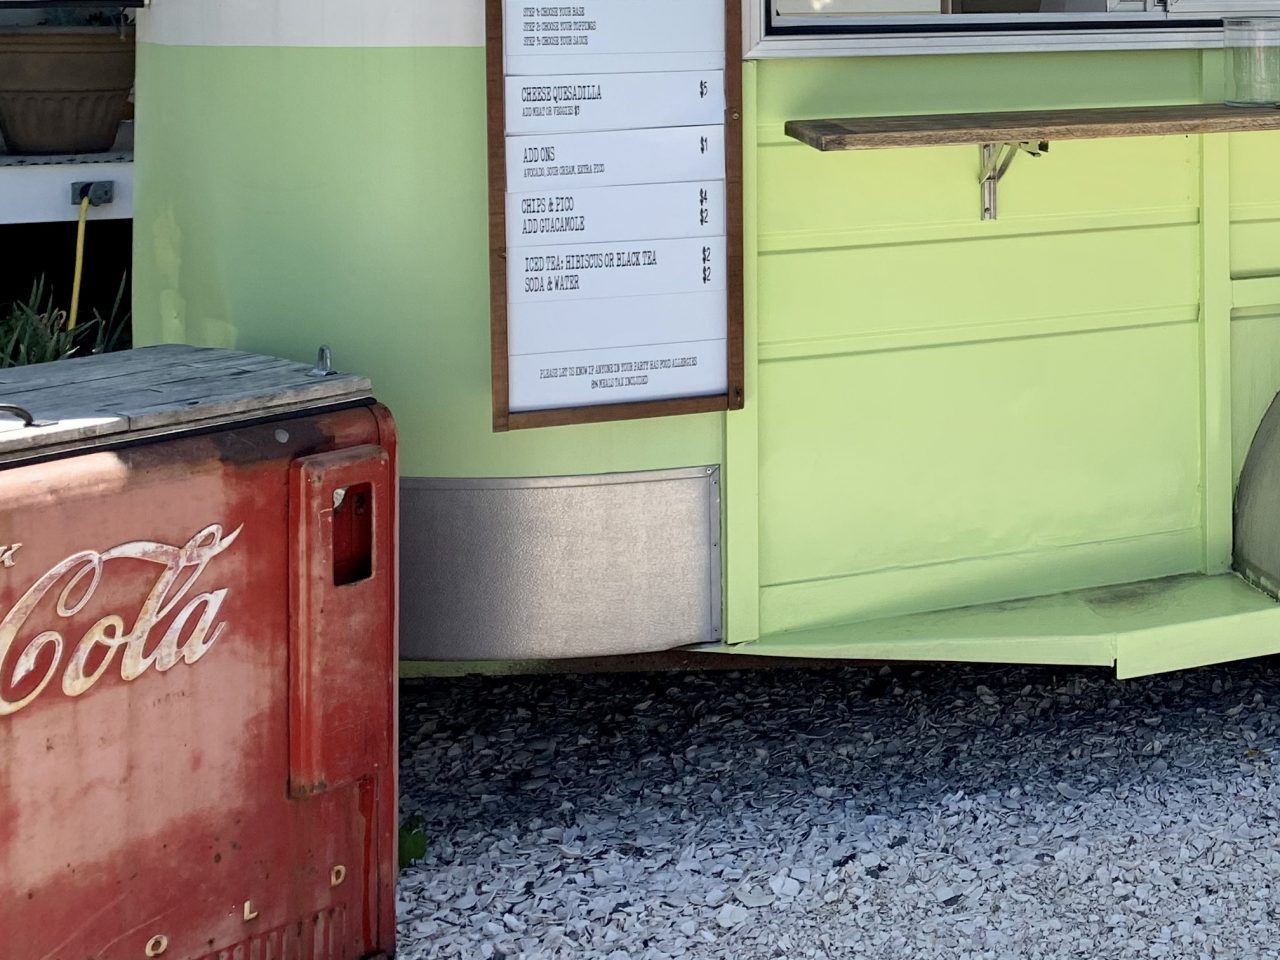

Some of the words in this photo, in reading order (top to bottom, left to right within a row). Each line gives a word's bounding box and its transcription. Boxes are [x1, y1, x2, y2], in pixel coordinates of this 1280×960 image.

[522, 86, 551, 102] CHEESE
[553, 85, 602, 103] QUESADILLA
[700, 80, 708, 98] $5
[700, 136, 708, 154] $1
[523, 147, 539, 163] ADD
[540, 146, 555, 162] ONS
[522, 197, 546, 214] CHIPS
[548, 197, 553, 213] &
[555, 197, 574, 212] PICO
[522, 218, 539, 234] ADD
[540, 215, 585, 234] GUACAMOLE
[700, 208, 708, 226] $2
[525, 256, 544, 272] ICED
[546, 255, 564, 271] TEA:
[565, 253, 603, 270] HIBISCUS
[604, 252, 614, 268] OR
[616, 251, 641, 268] BLACK
[642, 250, 657, 266] TEA
[702, 246, 710, 264] $2
[525, 276, 544, 293] SODA
[547, 276, 553, 292] &
[554, 274, 580, 291] WATER
[703, 266, 711, 284] $2
[0, 522, 244, 715] Cola
